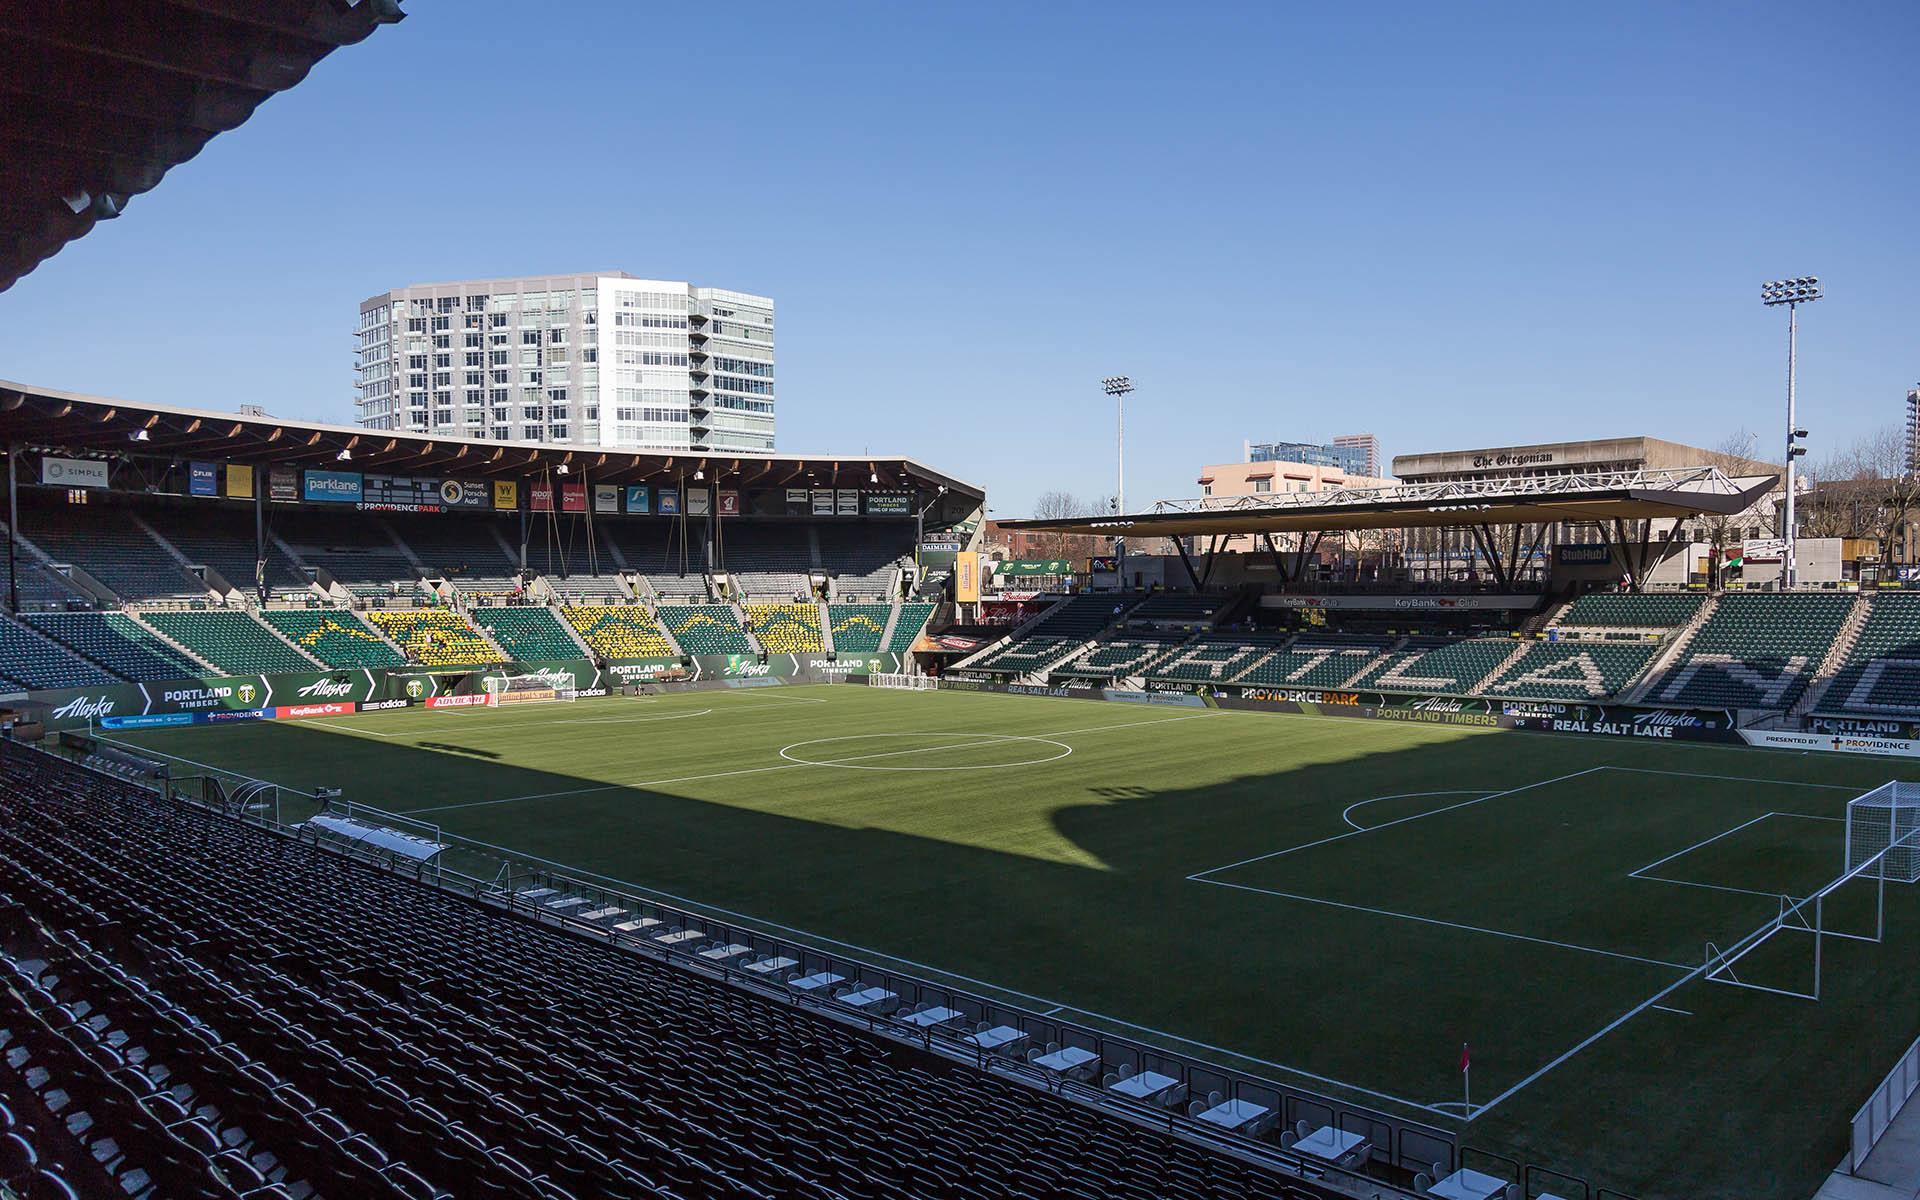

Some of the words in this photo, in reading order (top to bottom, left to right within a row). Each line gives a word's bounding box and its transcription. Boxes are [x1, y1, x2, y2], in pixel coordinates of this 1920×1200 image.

[1473, 456, 1493, 469] The
[1496, 451, 1553, 466] Oregonian
[68, 468, 104, 478] SIMPLE
[309, 479, 358, 492] parklane
[463, 481, 484, 489] Sunset
[1395, 599, 1436, 608] KeyBank
[1458, 599, 1479, 608] Club
[610, 664, 665, 675] PORTLAND
[959, 671, 992, 679] PORTLAND
[298, 678, 353, 698] Alaska
[950, 681, 980, 690] TIMBERS
[1060, 677, 1093, 690] Alaska
[1149, 681, 1193, 691] PORTLAND
[164, 687, 232, 702] PORTLAND
[580, 688, 606, 697] adidas
[1008, 685, 1027, 694] REAL
[1028, 687, 1048, 695] SALT
[1049, 688, 1069, 697] LAKE
[52, 695, 116, 720] Alaska
[179, 699, 219, 708] TIMBERS
[380, 699, 407, 710] adidas
[1413, 696, 1463, 712] Alaska
[1502, 701, 1567, 713] PORTLAND
[215, 710, 264, 721] PROVIDENCE
[289, 706, 324, 716] KeyBank
[1376, 708, 1441, 722] PORTLAND
[1444, 712, 1498, 726] TIMBERS
[1633, 708, 1697, 727] Alaska
[1553, 719, 1589, 733] REAL
[1592, 722, 1631, 735] SALT
[1633, 724, 1673, 738] LAKE
[1766, 736, 1807, 744] PRESENTED
[1846, 739, 1910, 750] PROVIDENCE
